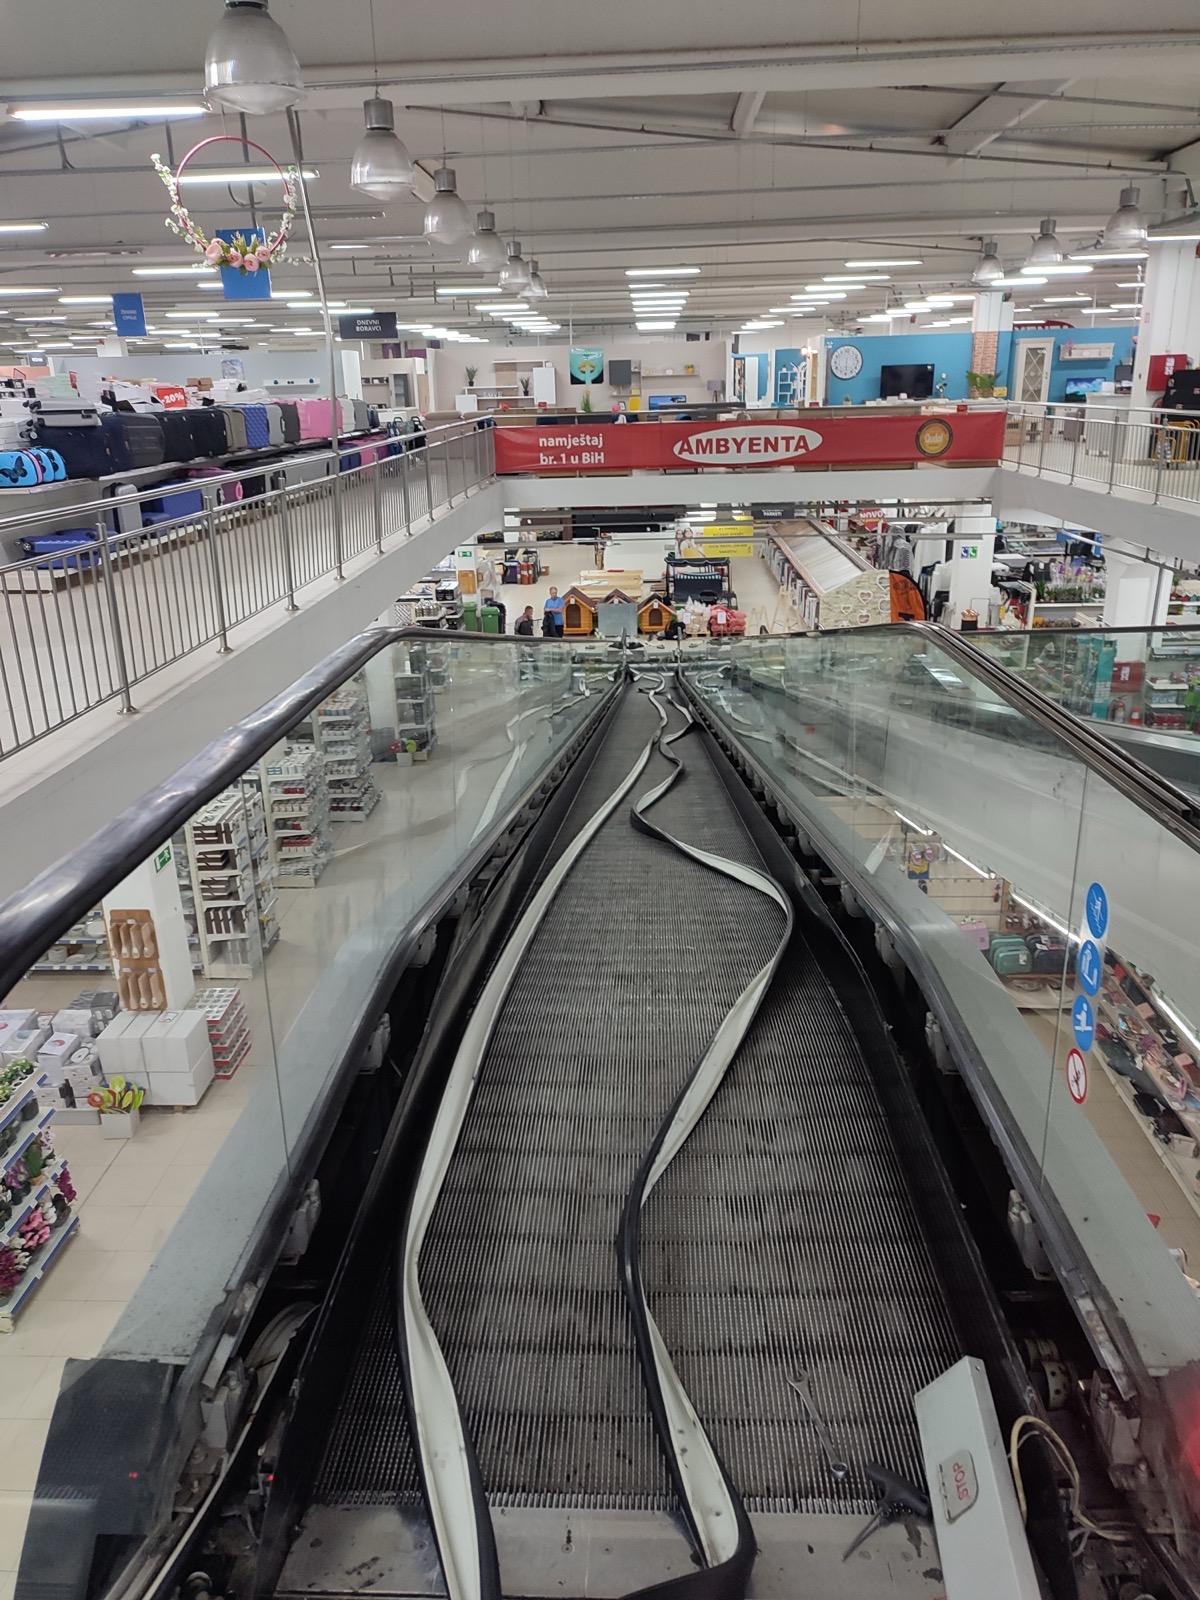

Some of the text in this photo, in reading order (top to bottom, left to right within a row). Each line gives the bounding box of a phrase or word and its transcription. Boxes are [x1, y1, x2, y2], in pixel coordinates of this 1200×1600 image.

[538, 433, 603, 449] namještaj
[678, 435, 810, 455] AMBYENTA
[540, 451, 605, 465] br. 1 u BiH
[953, 1462, 970, 1501] STOP
